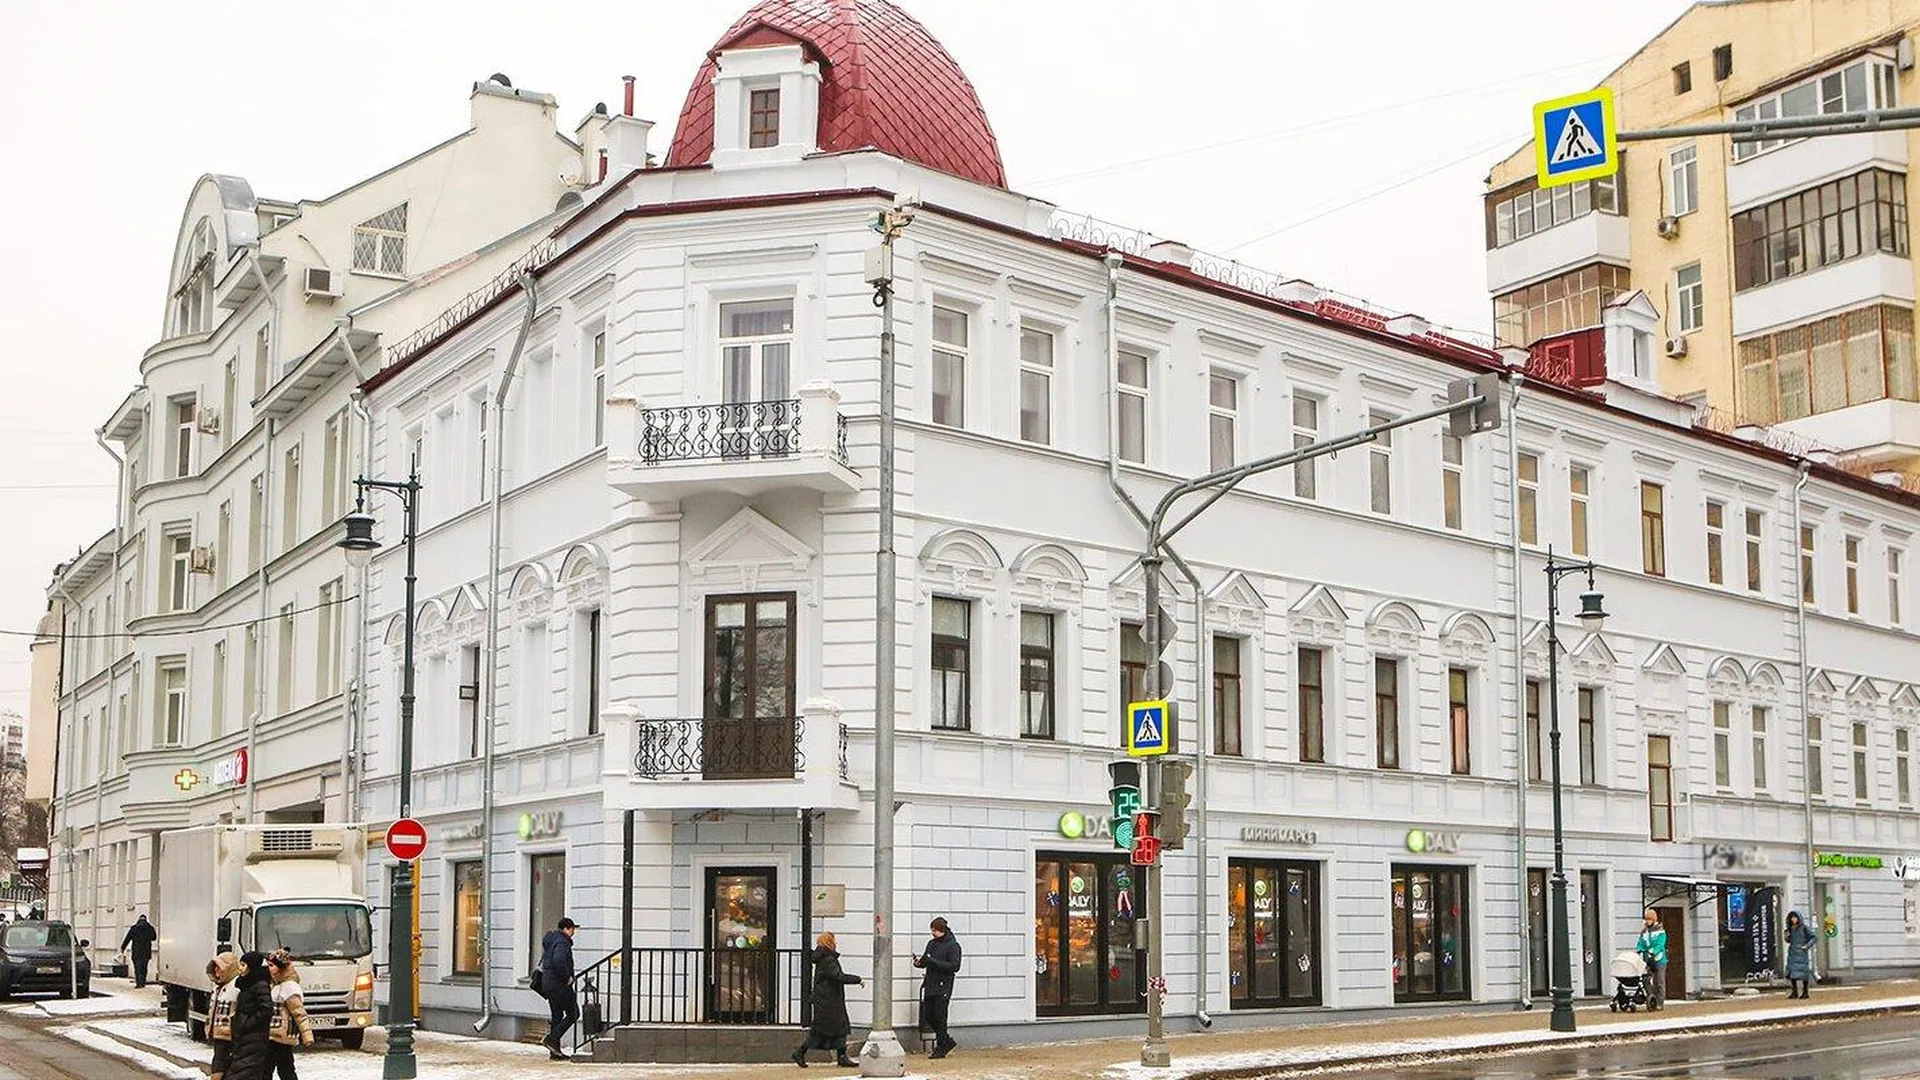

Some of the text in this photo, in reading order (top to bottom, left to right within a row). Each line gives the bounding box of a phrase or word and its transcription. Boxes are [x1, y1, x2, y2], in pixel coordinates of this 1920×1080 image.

[1119, 793, 1141, 818] 25
[1136, 839, 1154, 863] 28
[1425, 831, 1464, 854] DAILY
